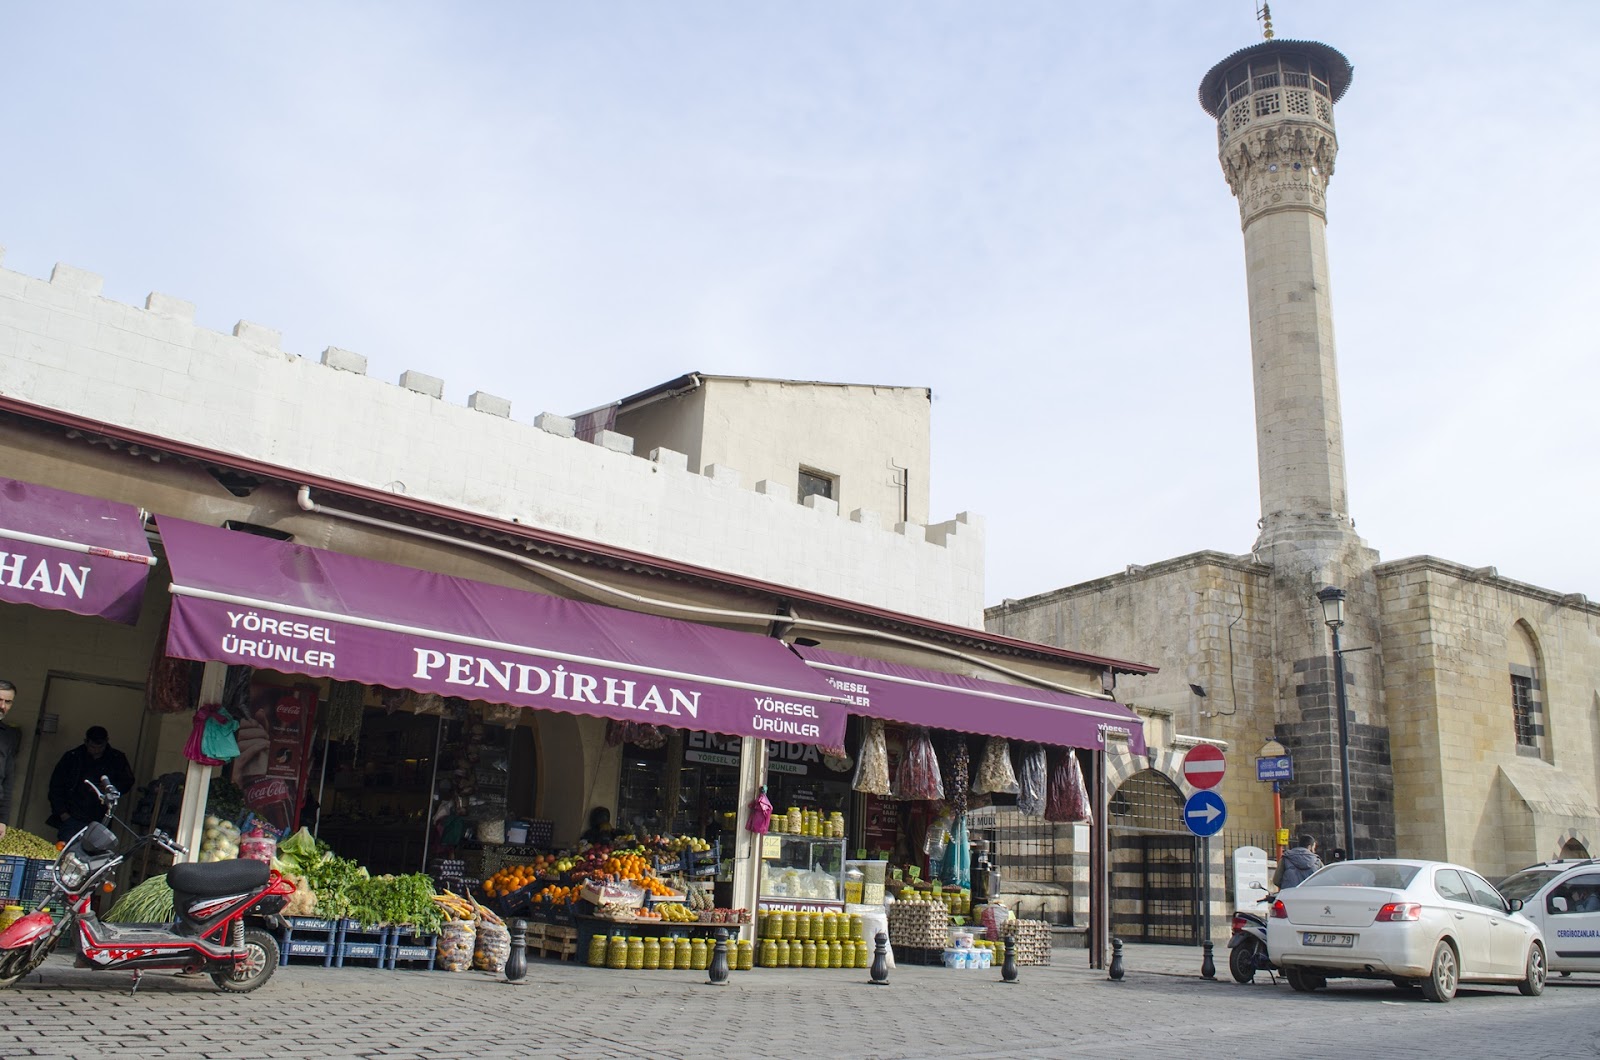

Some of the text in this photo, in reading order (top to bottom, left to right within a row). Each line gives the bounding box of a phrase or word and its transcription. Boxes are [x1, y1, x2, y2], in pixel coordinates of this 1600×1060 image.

[226, 611, 336, 645] YÖRESEL
[221, 633, 336, 669] ÜRÜNLER
[412, 647, 702, 719] PENDİRHAN
[825, 677, 870, 695] ÖRESEL
[754, 697, 819, 719] YÖRESEL
[752, 715, 820, 738] ÜRÜNLER
[689, 731, 740, 752] EME
[1307, 934, 1352, 944] 27 AUP 79
